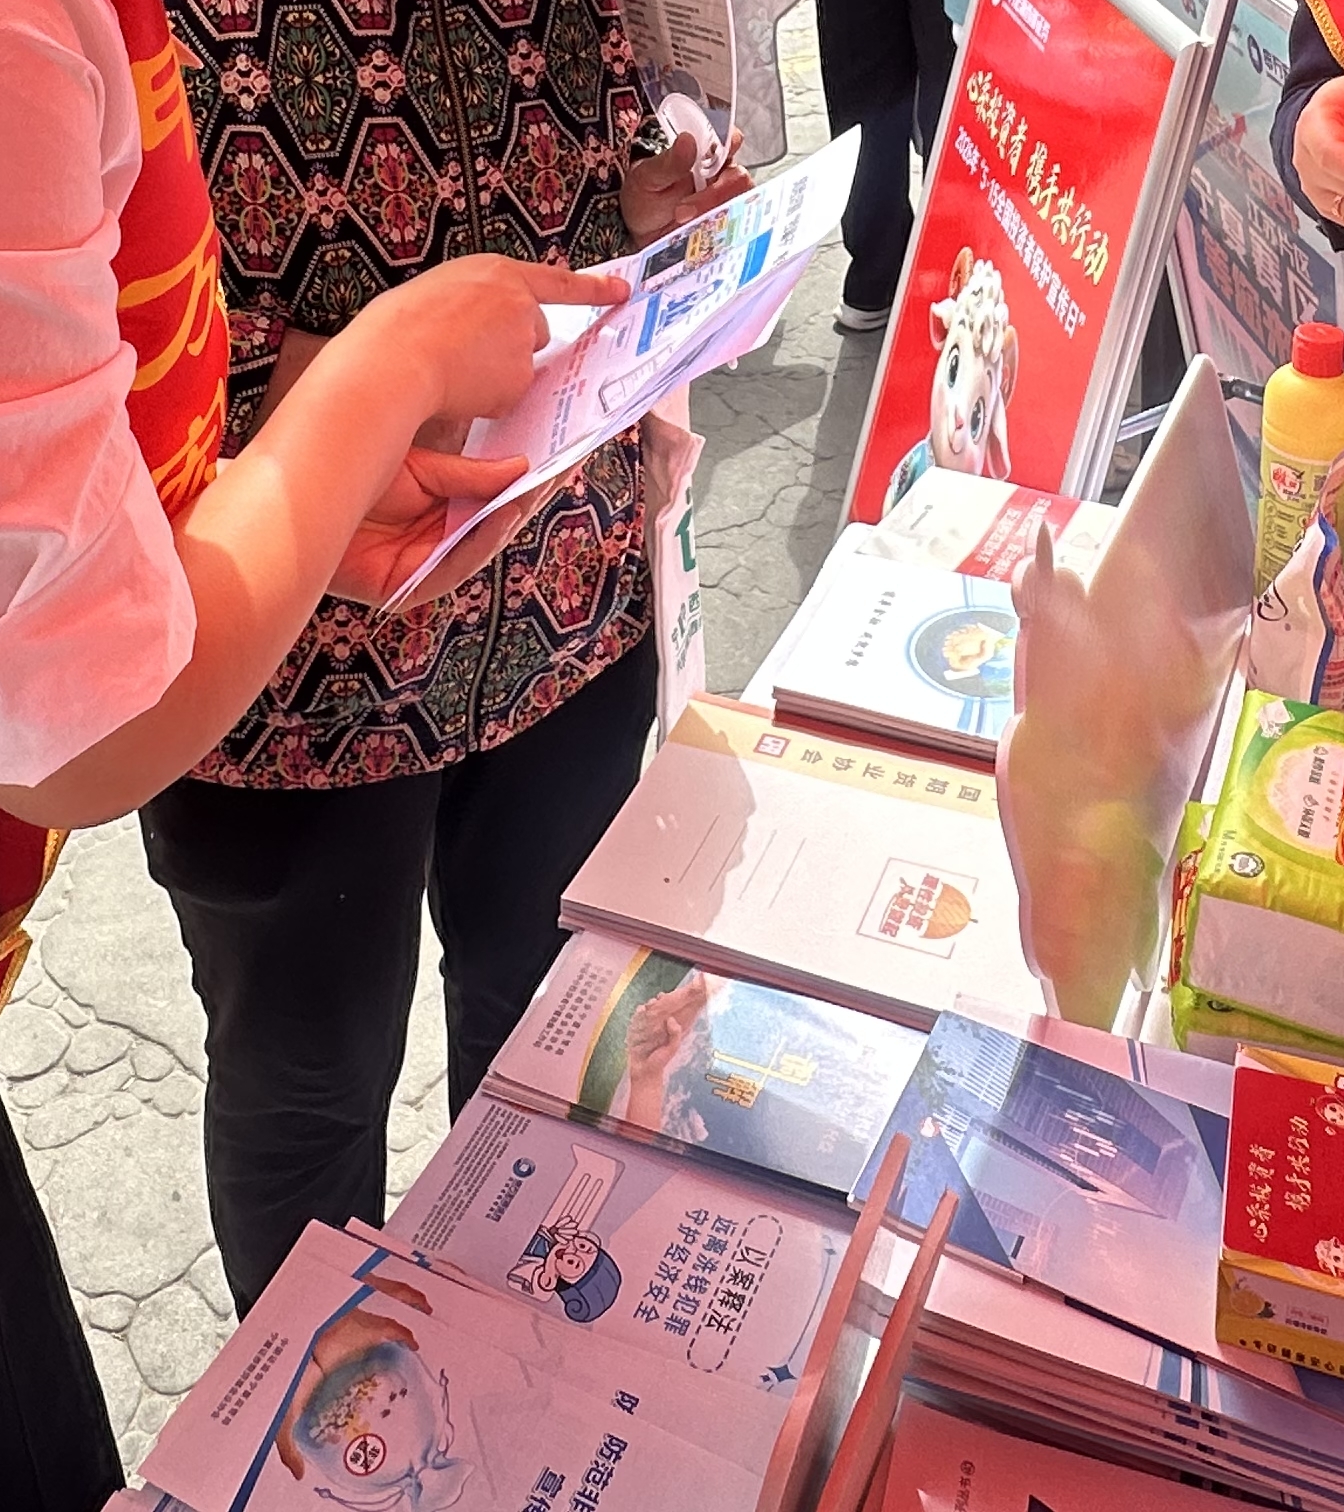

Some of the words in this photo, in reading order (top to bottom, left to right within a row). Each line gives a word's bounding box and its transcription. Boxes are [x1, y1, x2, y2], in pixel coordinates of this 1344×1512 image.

[801, 748, 998, 803] 国期货业协会
[632, 1208, 710, 1324] 守护经济安全
[663, 1214, 740, 1337] 远离洗钱犯罪
[705, 1245, 768, 1335] 以案释法
